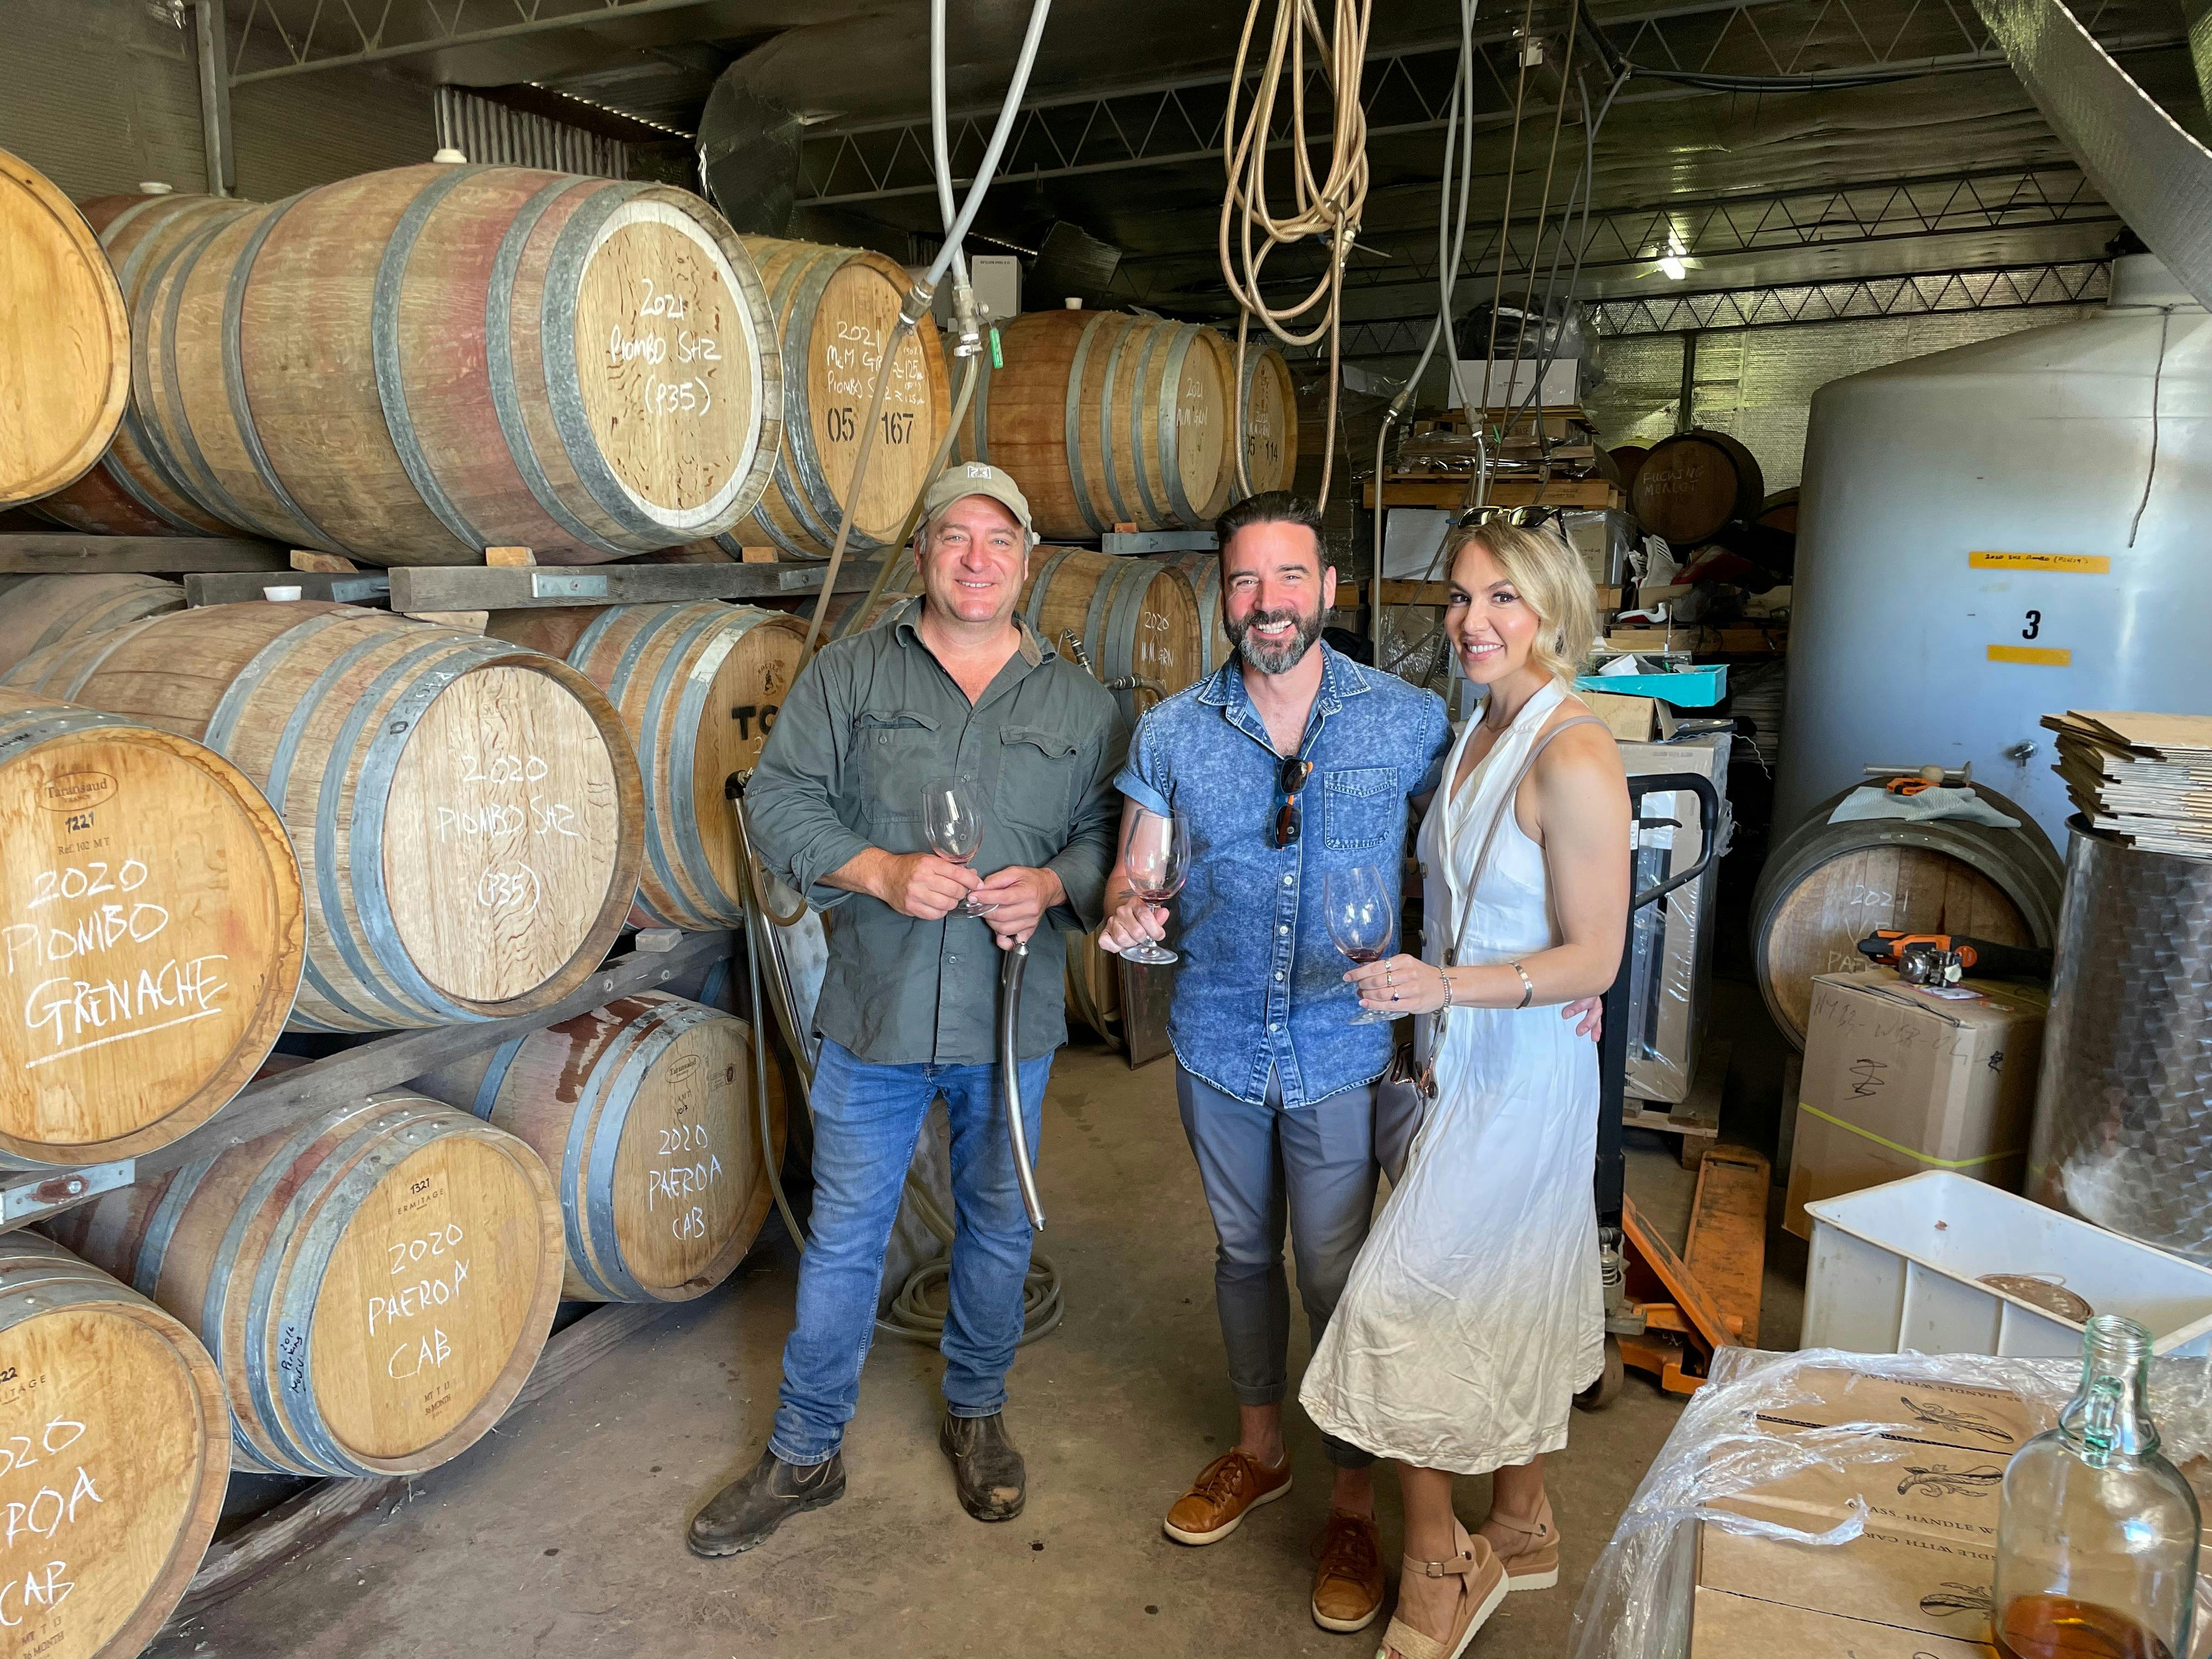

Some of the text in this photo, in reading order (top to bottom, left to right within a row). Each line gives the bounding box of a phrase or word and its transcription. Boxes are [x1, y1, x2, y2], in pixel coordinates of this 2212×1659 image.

[640, 278, 684, 320] 2021
[838, 321, 880, 353] 2021
[867, 376, 891, 400] SZ
[1186, 377, 1203, 399] 2021
[827, 408, 914, 444] 05 167
[1266, 441, 1278, 462] 114
[2022, 610, 2041, 639] 3
[461, 755, 548, 784] 2020
[47, 777, 108, 799] Taransaud
[65, 811, 94, 834] 1221
[437, 803, 524, 843] PIOMBO
[28, 859, 148, 909] 2020
[478, 861, 540, 916] (P35)
[1850, 884, 1909, 912] 2021
[2, 903, 169, 974] PIOMBO
[25, 955, 229, 1045] GRENACHE
[658, 1124, 708, 1155] 2020
[410, 1178, 431, 1194] 1321
[650, 1154, 723, 1212] PAEROA
[398, 1188, 444, 1215] ERMITAGE
[673, 1206, 705, 1240] CAB
[388, 1223, 464, 1274] 2020
[369, 1259, 470, 1338] PAEROA
[388, 1325, 452, 1379] CAB
[0, 1367, 18, 1385] 22
[0, 1374, 46, 1401] ITAGE
[1894, 1378, 1934, 1390] WITH
[1938, 1385, 1998, 1399] HANDLE
[0, 1466, 104, 1549] ROA
[1864, 1531, 1899, 1543] CAR
[1906, 1514, 1975, 1531] HANDLE
[1906, 1539, 1954, 1554] WITH
[0, 1561, 75, 1626] CAB
[33, 1630, 65, 1657] MONTH
